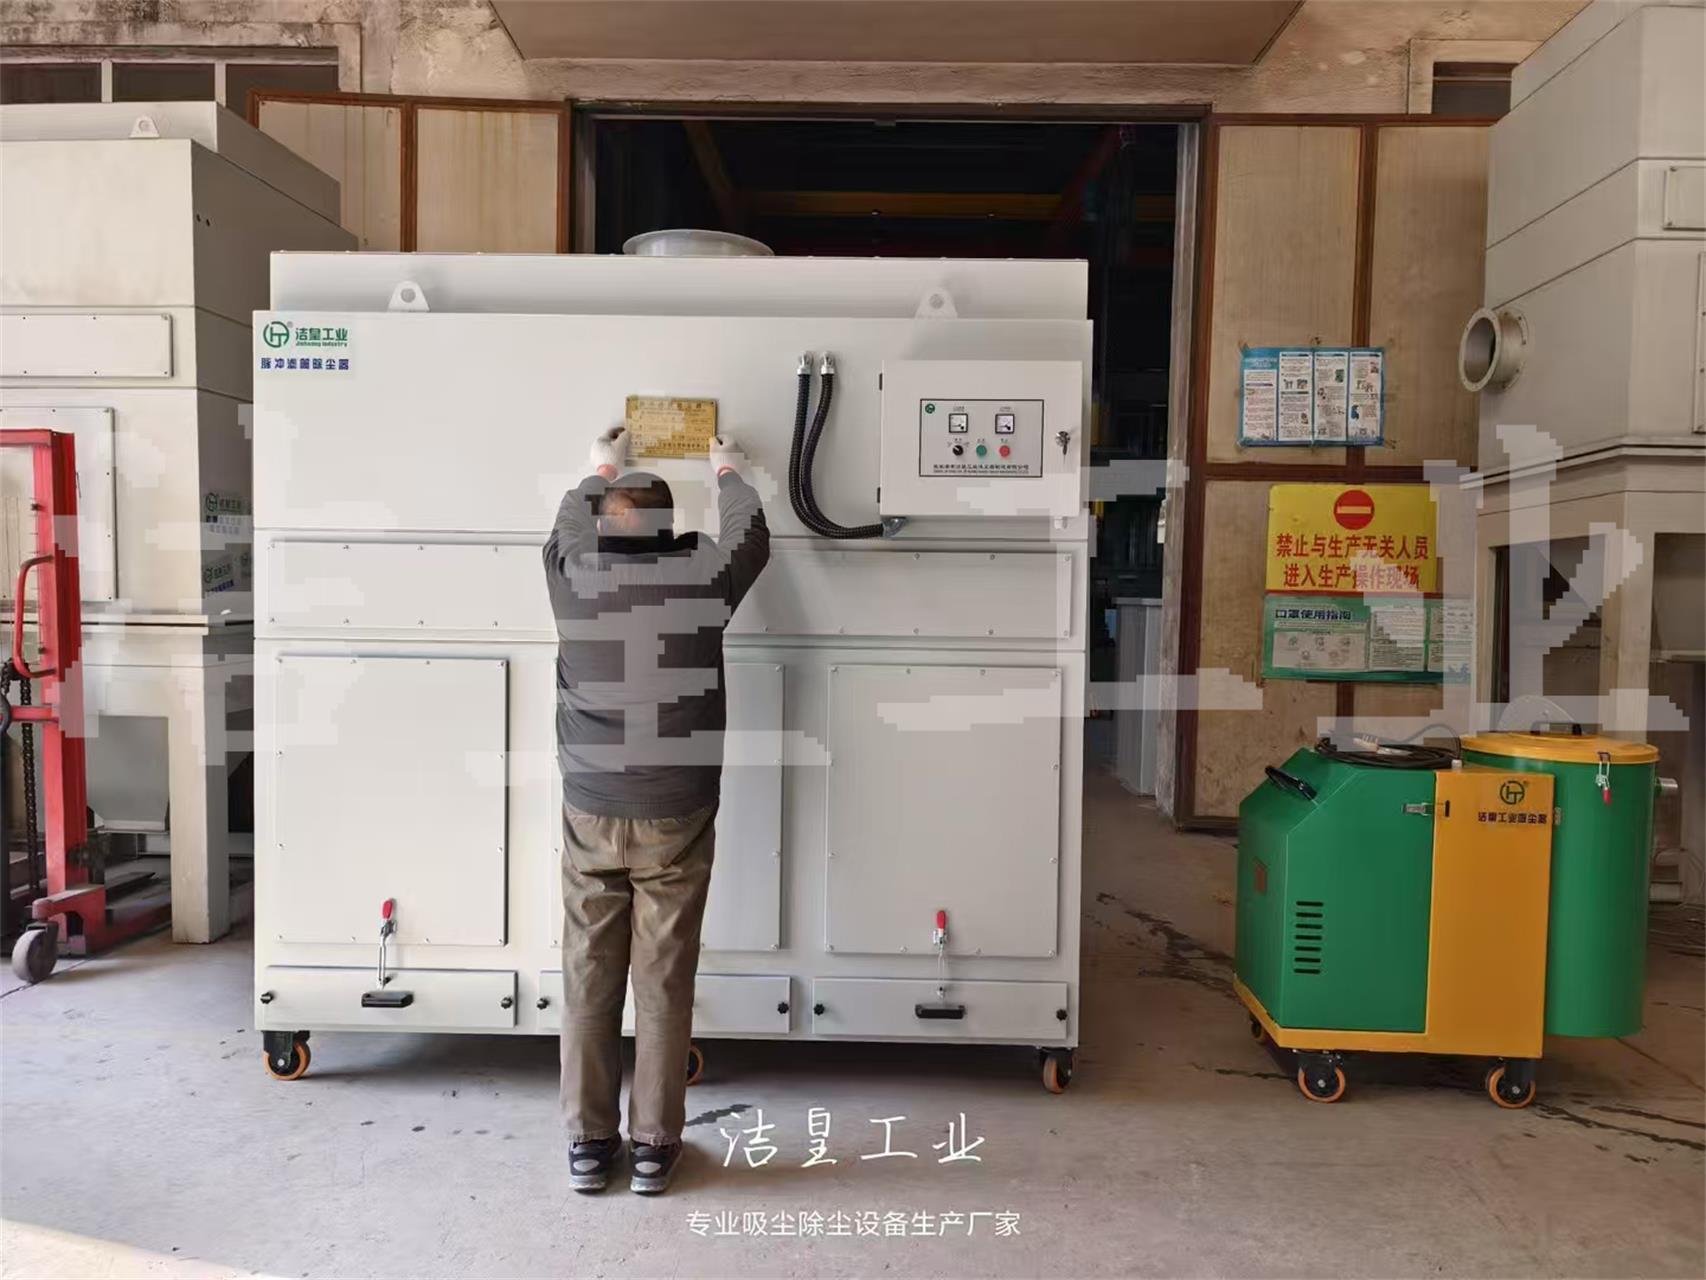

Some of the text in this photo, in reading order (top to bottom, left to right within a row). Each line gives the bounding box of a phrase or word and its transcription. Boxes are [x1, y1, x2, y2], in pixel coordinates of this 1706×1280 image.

[295, 327, 348, 341] 洁皇工业
[1276, 534, 1428, 559] 禁止与生产无关人员
[1283, 563, 1420, 589] 进入生产操作现场
[1275, 607, 1351, 620] 口罩使用指南
